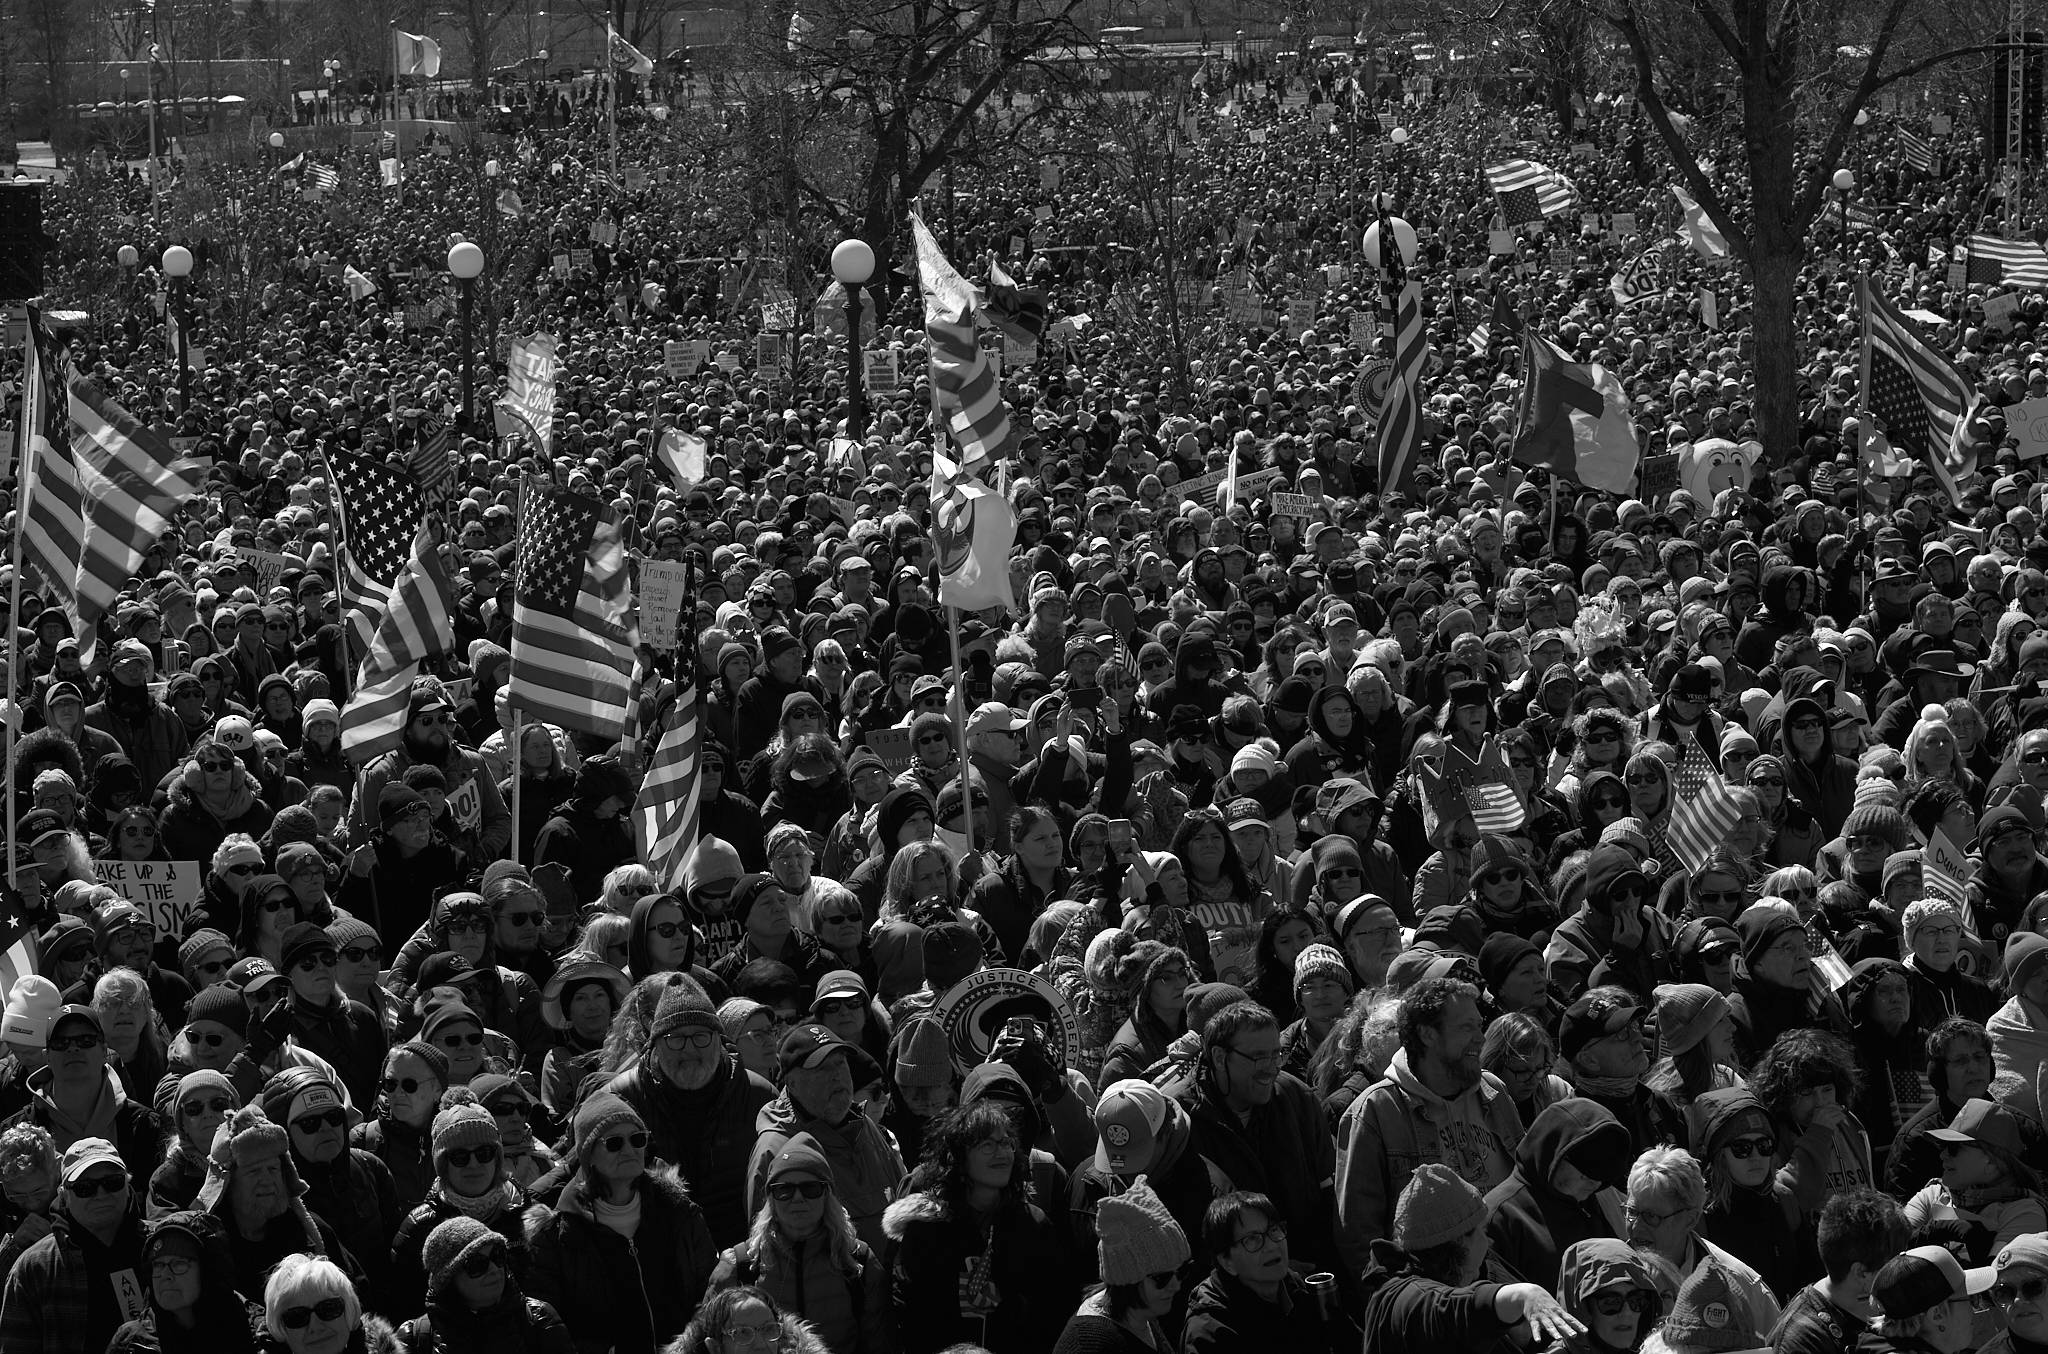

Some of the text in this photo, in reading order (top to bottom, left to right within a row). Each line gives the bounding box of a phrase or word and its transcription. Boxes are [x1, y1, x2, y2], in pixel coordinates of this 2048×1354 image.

[406, 313, 431, 321] THINK
[409, 305, 430, 313] READ
[410, 320, 429, 328] VOTE
[677, 354, 696, 362] FOUNDERS
[869, 382, 878, 390] NO
[2007, 408, 2028, 424] NO
[2035, 426, 2048, 443] KI
[1643, 461, 1676, 477] LOVE
[1169, 471, 1229, 495] REJECTING KINGS
[1240, 474, 1269, 488] NO KING
[1642, 472, 1677, 488] TRUMPS
[257, 556, 281, 577] King
[643, 561, 673, 583] Trump
[649, 614, 666, 624] jail
[874, 733, 909, 744] 1938
[96, 863, 126, 881] AKE
[134, 864, 153, 880] UP
[1935, 847, 1966, 882] DUMP
[139, 883, 174, 900] THE
[699, 918, 743, 940] CAN'T
[966, 971, 1039, 990] JUSTICE
[1057, 1004, 1079, 1067] LIBERT
